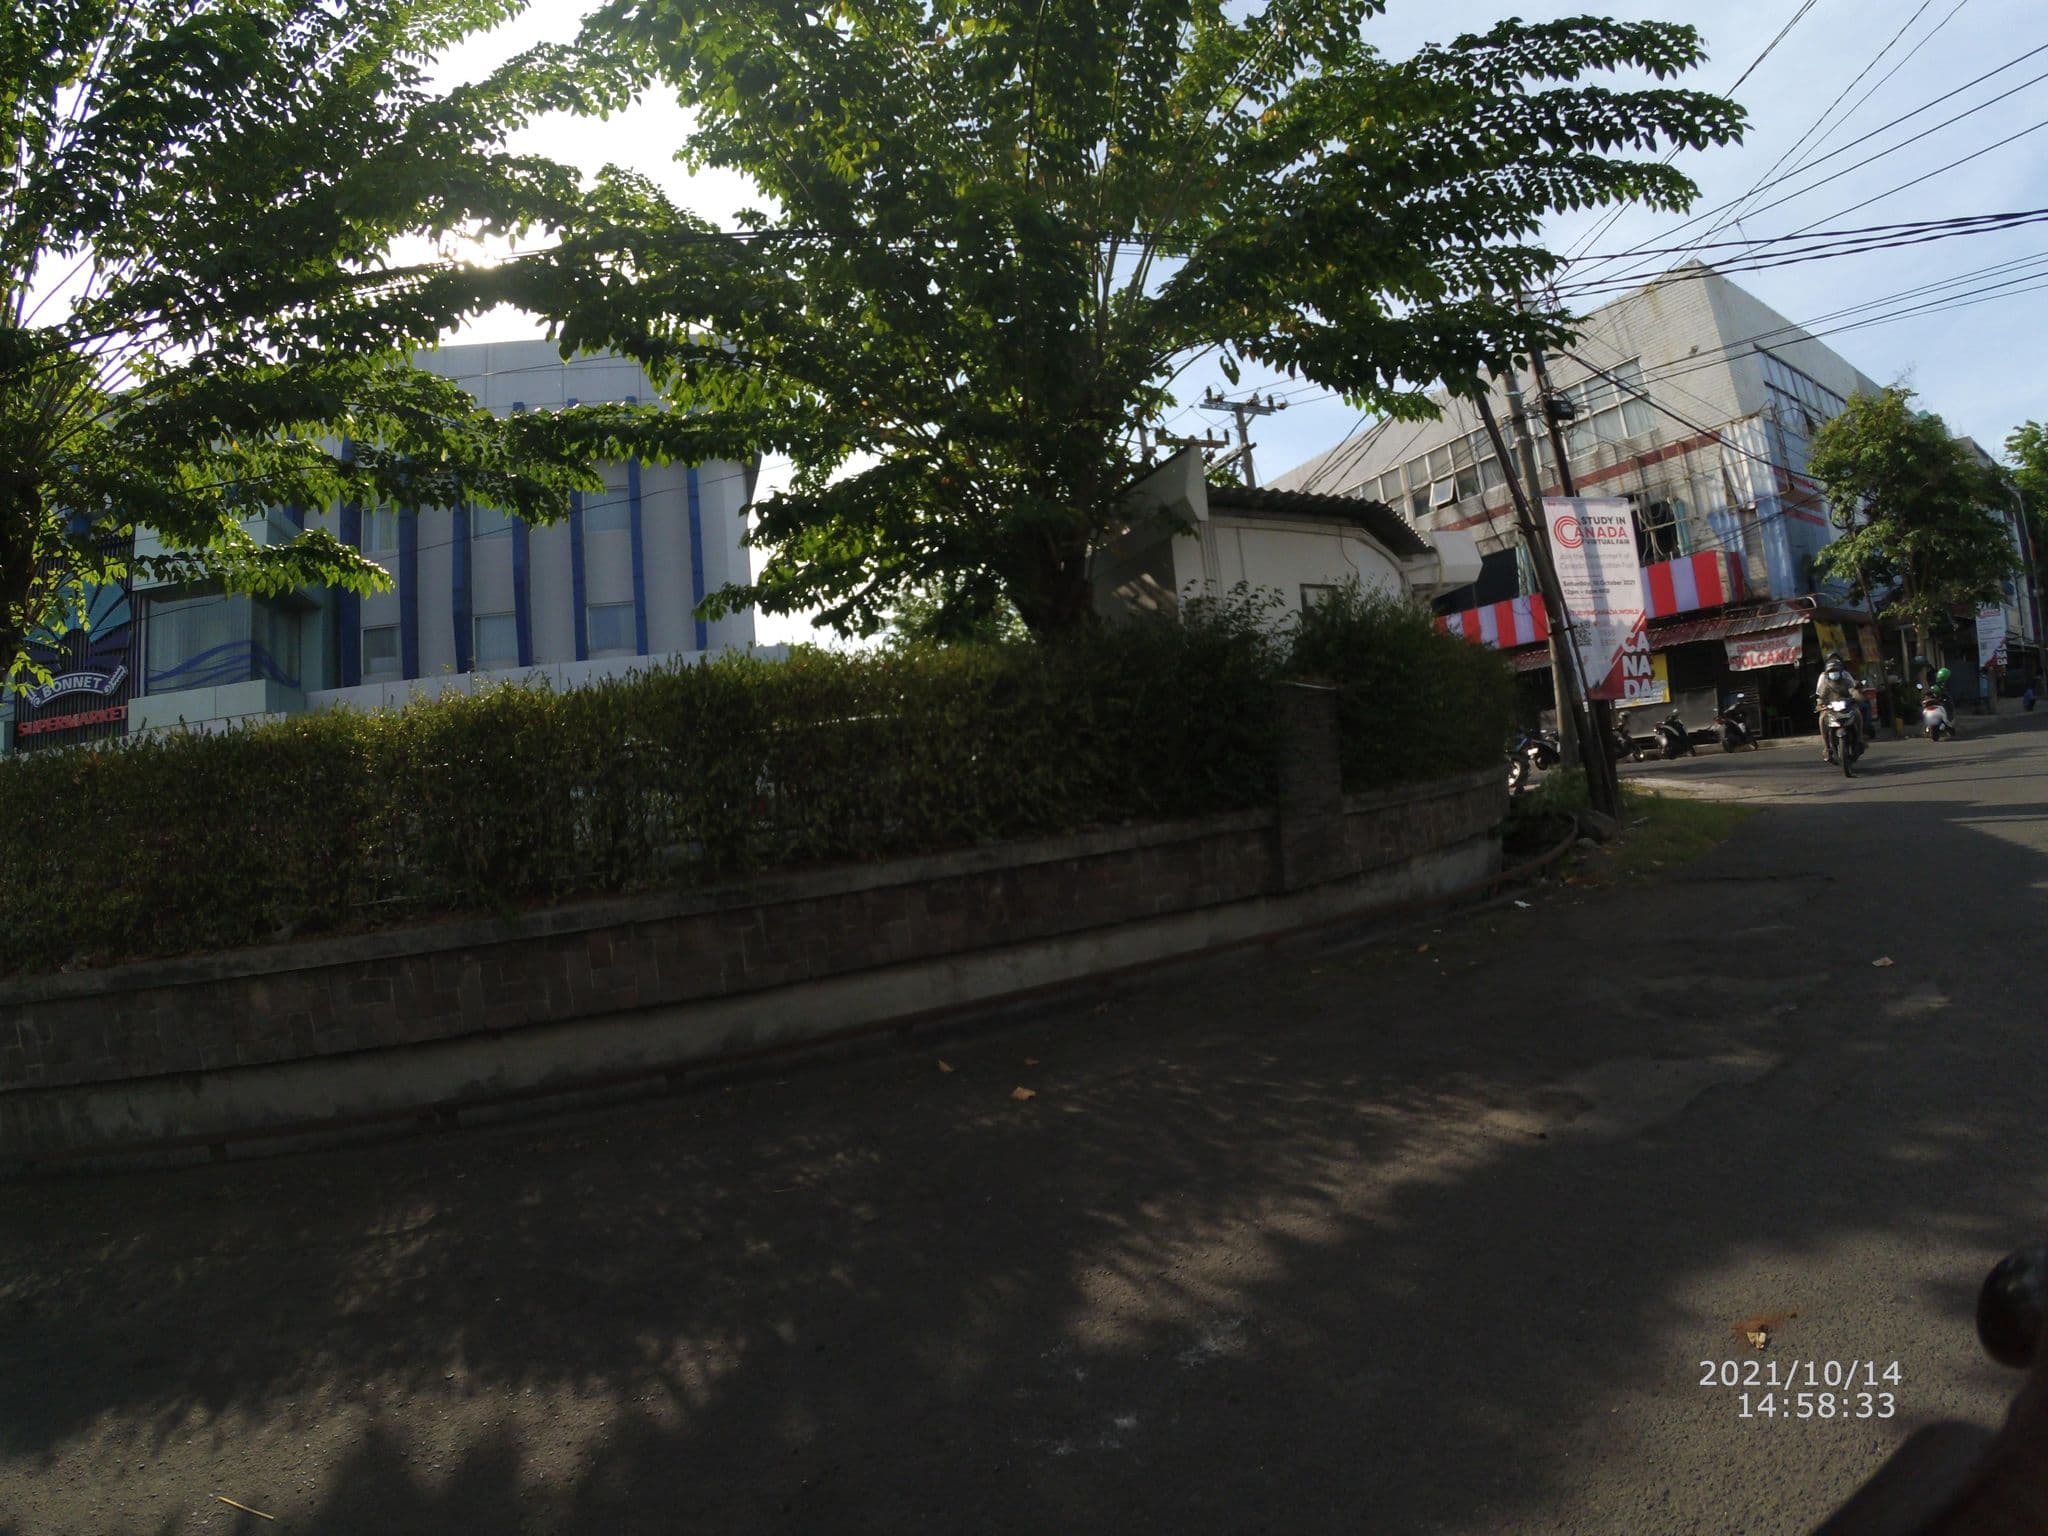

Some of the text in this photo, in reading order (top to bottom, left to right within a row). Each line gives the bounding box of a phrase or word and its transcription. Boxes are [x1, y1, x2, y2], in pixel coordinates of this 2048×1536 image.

[1554, 515, 1628, 548] CANADA
[1580, 516, 1626, 525] STUDY IN
[1622, 630, 1650, 653] CA
[1622, 654, 1652, 677] NA
[42, 676, 103, 698] BONNET
[1623, 678, 1653, 699] DA
[17, 706, 128, 736] SUPERMARKET
